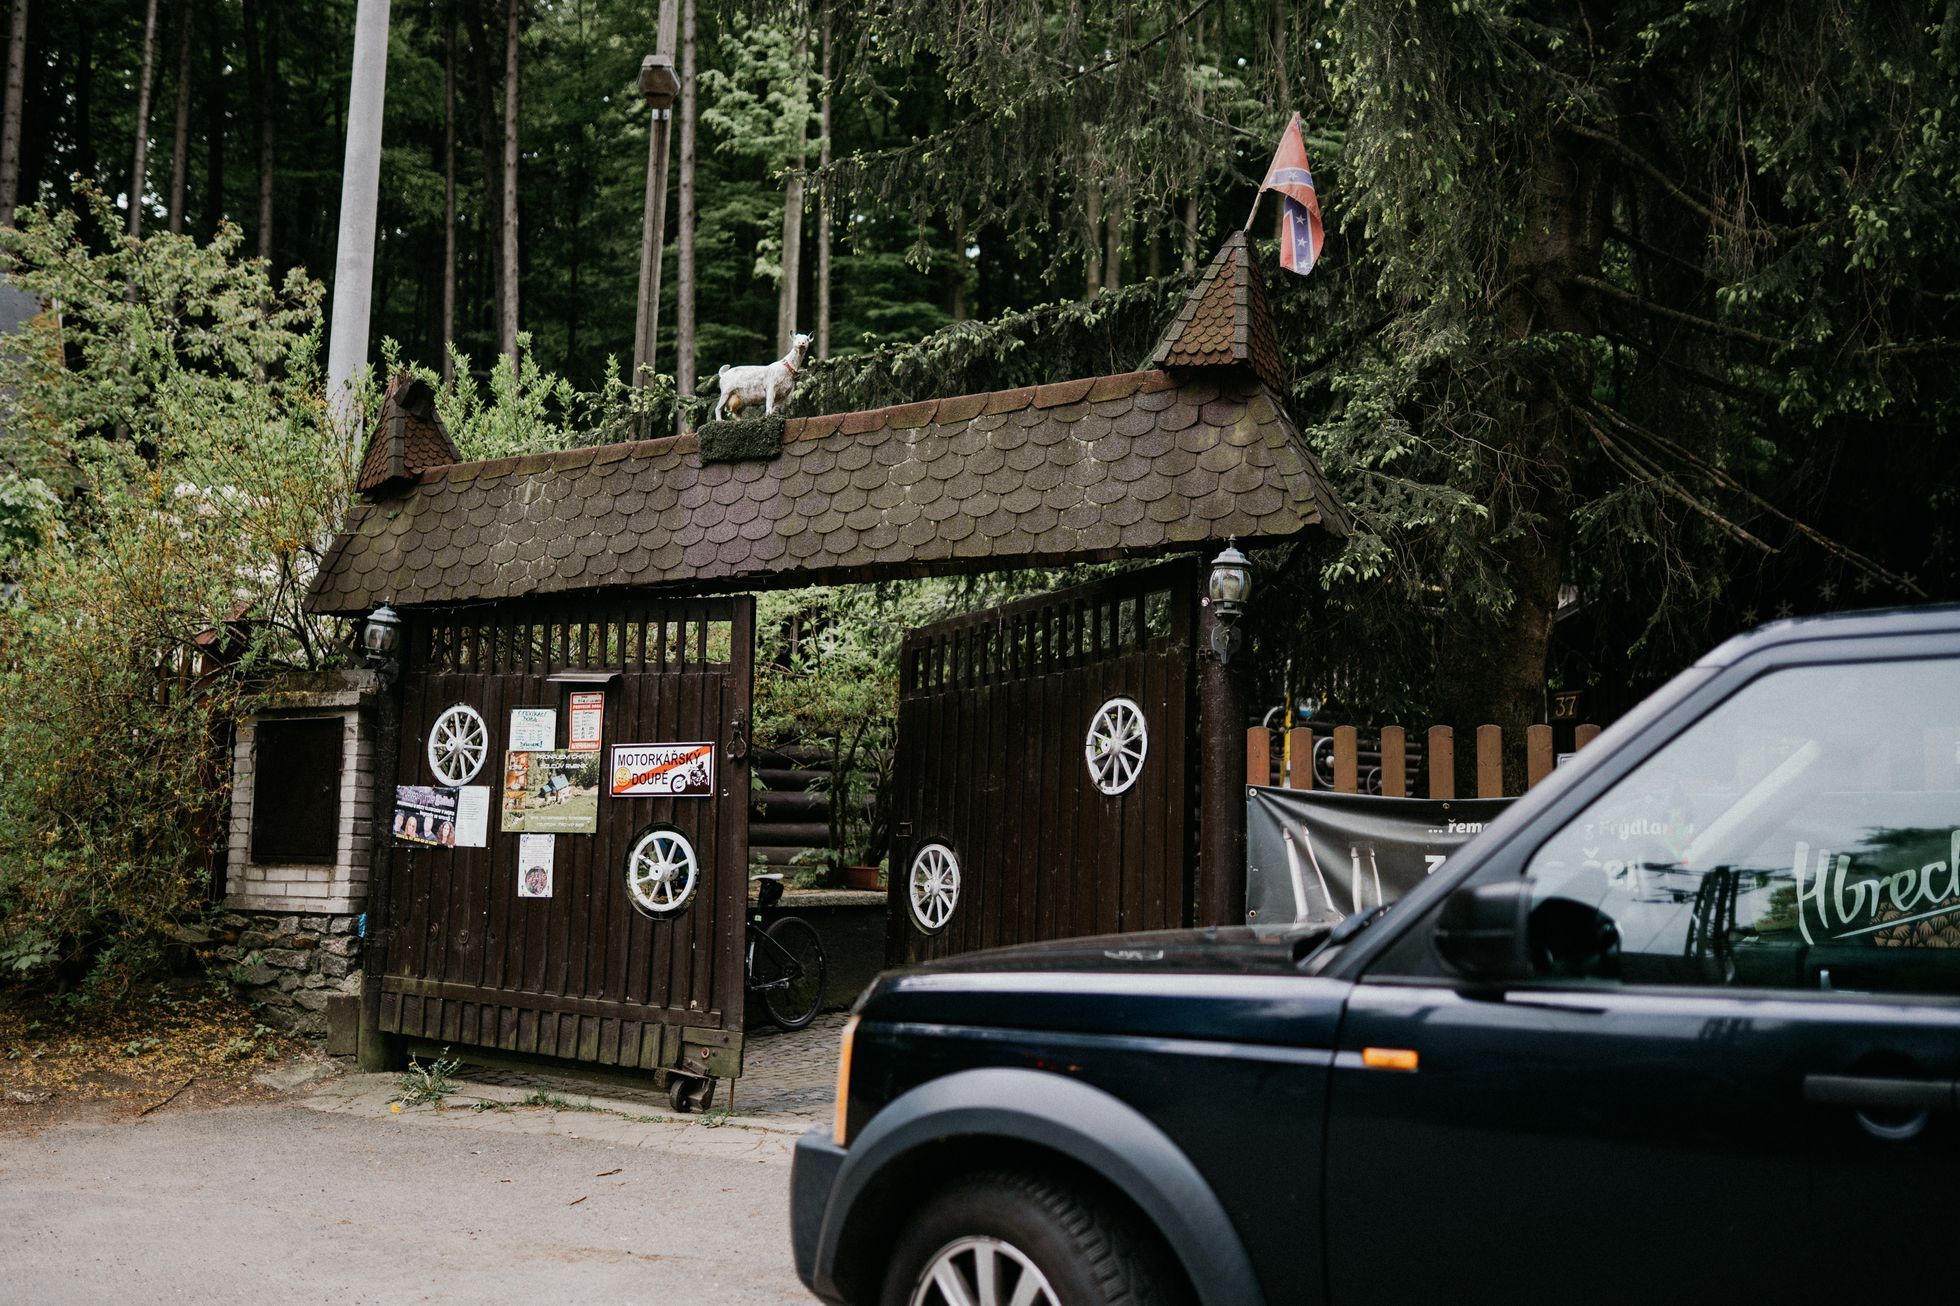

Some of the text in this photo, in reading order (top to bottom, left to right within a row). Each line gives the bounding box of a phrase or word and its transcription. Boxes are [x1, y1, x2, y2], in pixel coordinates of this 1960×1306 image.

[1555, 696, 1576, 716] 37
[617, 749, 701, 766] MOTORKÁŘSKÝ
[631, 769, 669, 785] DOUPĚ
